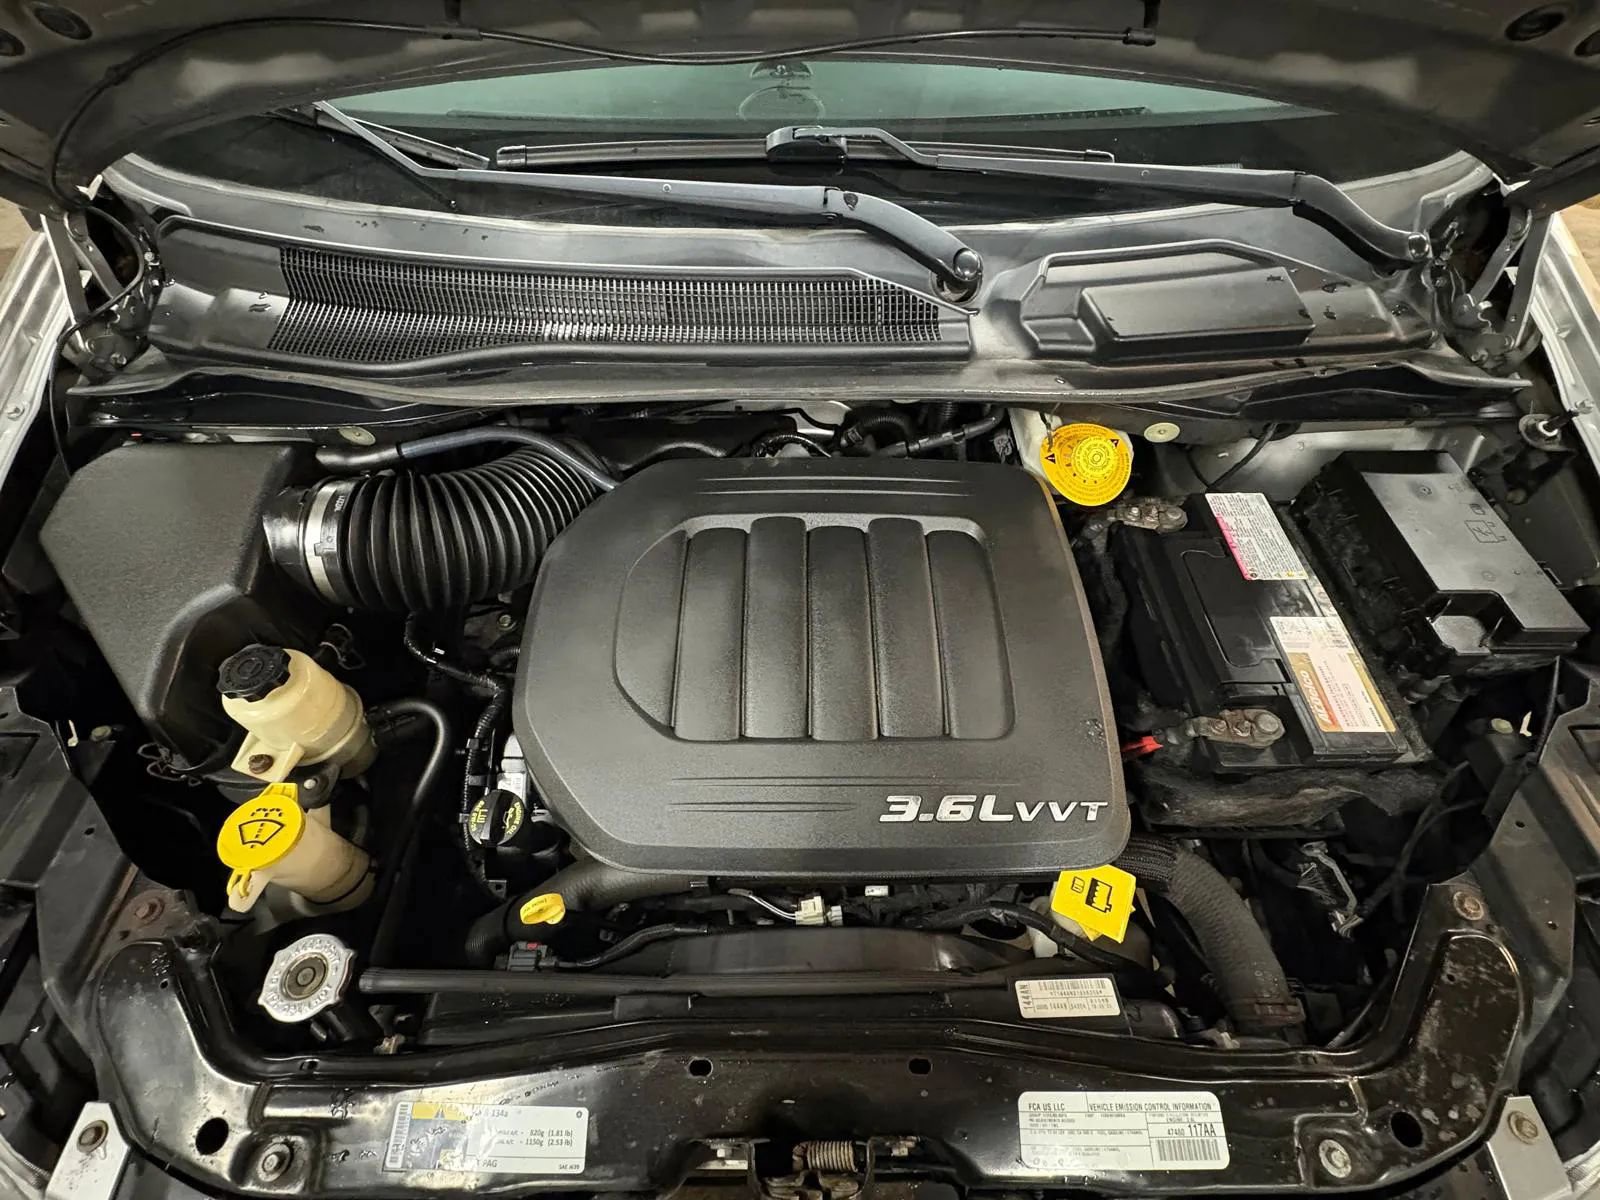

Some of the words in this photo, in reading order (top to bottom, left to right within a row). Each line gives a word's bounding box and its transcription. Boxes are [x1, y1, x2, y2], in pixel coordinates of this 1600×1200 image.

[1300, 670, 1331, 723] ACDelco
[513, 801, 523, 825] ENGINE
[879, 795, 1014, 822] 3.6L
[1015, 801, 1109, 822] VVT
[506, 825, 517, 835] OIL
[1028, 1103, 1041, 1111] FCA
[1043, 1103, 1052, 1111] US
[1053, 1103, 1065, 1111] LLC
[1089, 1103, 1113, 1111] VEHICLE
[1115, 1103, 1143, 1111] EMISSION
[1144, 1103, 1170, 1111] CONTROL
[1172, 1103, 1211, 1111] INFORMATION
[1187, 1123, 1216, 1137] 117AA
